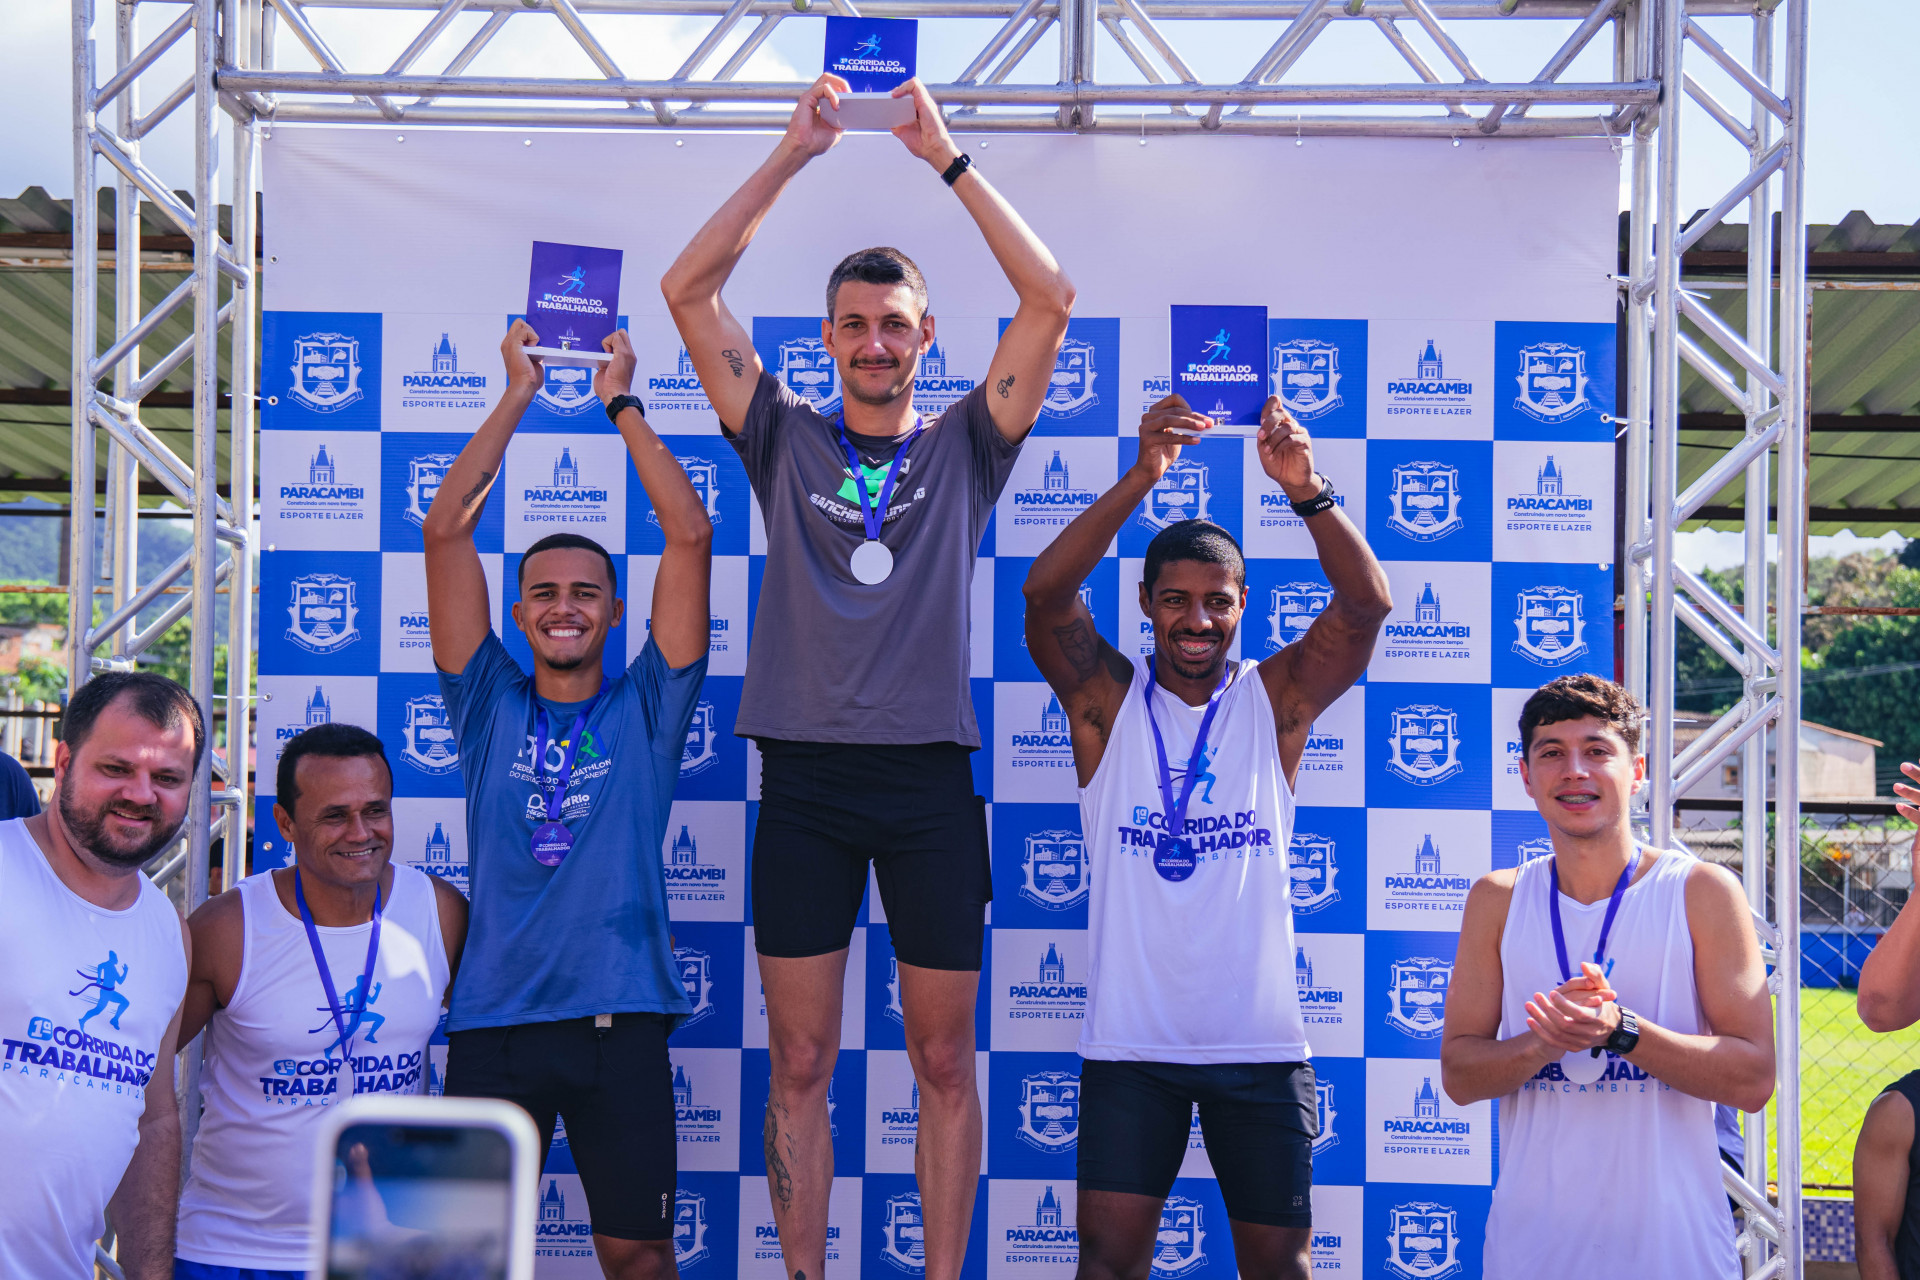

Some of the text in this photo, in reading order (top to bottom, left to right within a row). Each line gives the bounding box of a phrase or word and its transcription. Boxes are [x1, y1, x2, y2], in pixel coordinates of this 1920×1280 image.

[848, 58, 886, 66] CORRIDA
[832, 64, 906, 73] TRABALHADOR
[552, 295, 589, 305] CORRIDA
[589, 299, 603, 307] DO
[536, 300, 608, 315] TRABALHADOR
[1196, 364, 1236, 373] CORRIDA
[1237, 365, 1251, 373] DO
[403, 376, 486, 387] PARACAMBI
[1180, 372, 1258, 382] TRABALHADOR
[1388, 382, 1472, 394] PARACAMBI
[280, 487, 364, 499] PARACAMBI
[524, 490, 607, 502] PARACAMBI
[1507, 498, 1592, 510] PARACAMBI
[1507, 523, 1551, 531] ESPORTE
[1385, 625, 1470, 638] PARACAMBI
[1012, 735, 1071, 747] PARACA
[1235, 810, 1256, 829] DO
[1385, 877, 1470, 890] PARACAMBI
[1010, 986, 1087, 998] PARACAMB
[53, 1026, 133, 1065] CORRIDA
[397, 1051, 421, 1071] DO
[2, 1062, 130, 1096] PARACAMBI
[1384, 1121, 1470, 1134] PARACAMBI
[1384, 1146, 1429, 1154] ESPORTE
[1006, 1230, 1078, 1242] PARACAM
[1006, 1255, 1050, 1263] ESPORTE
